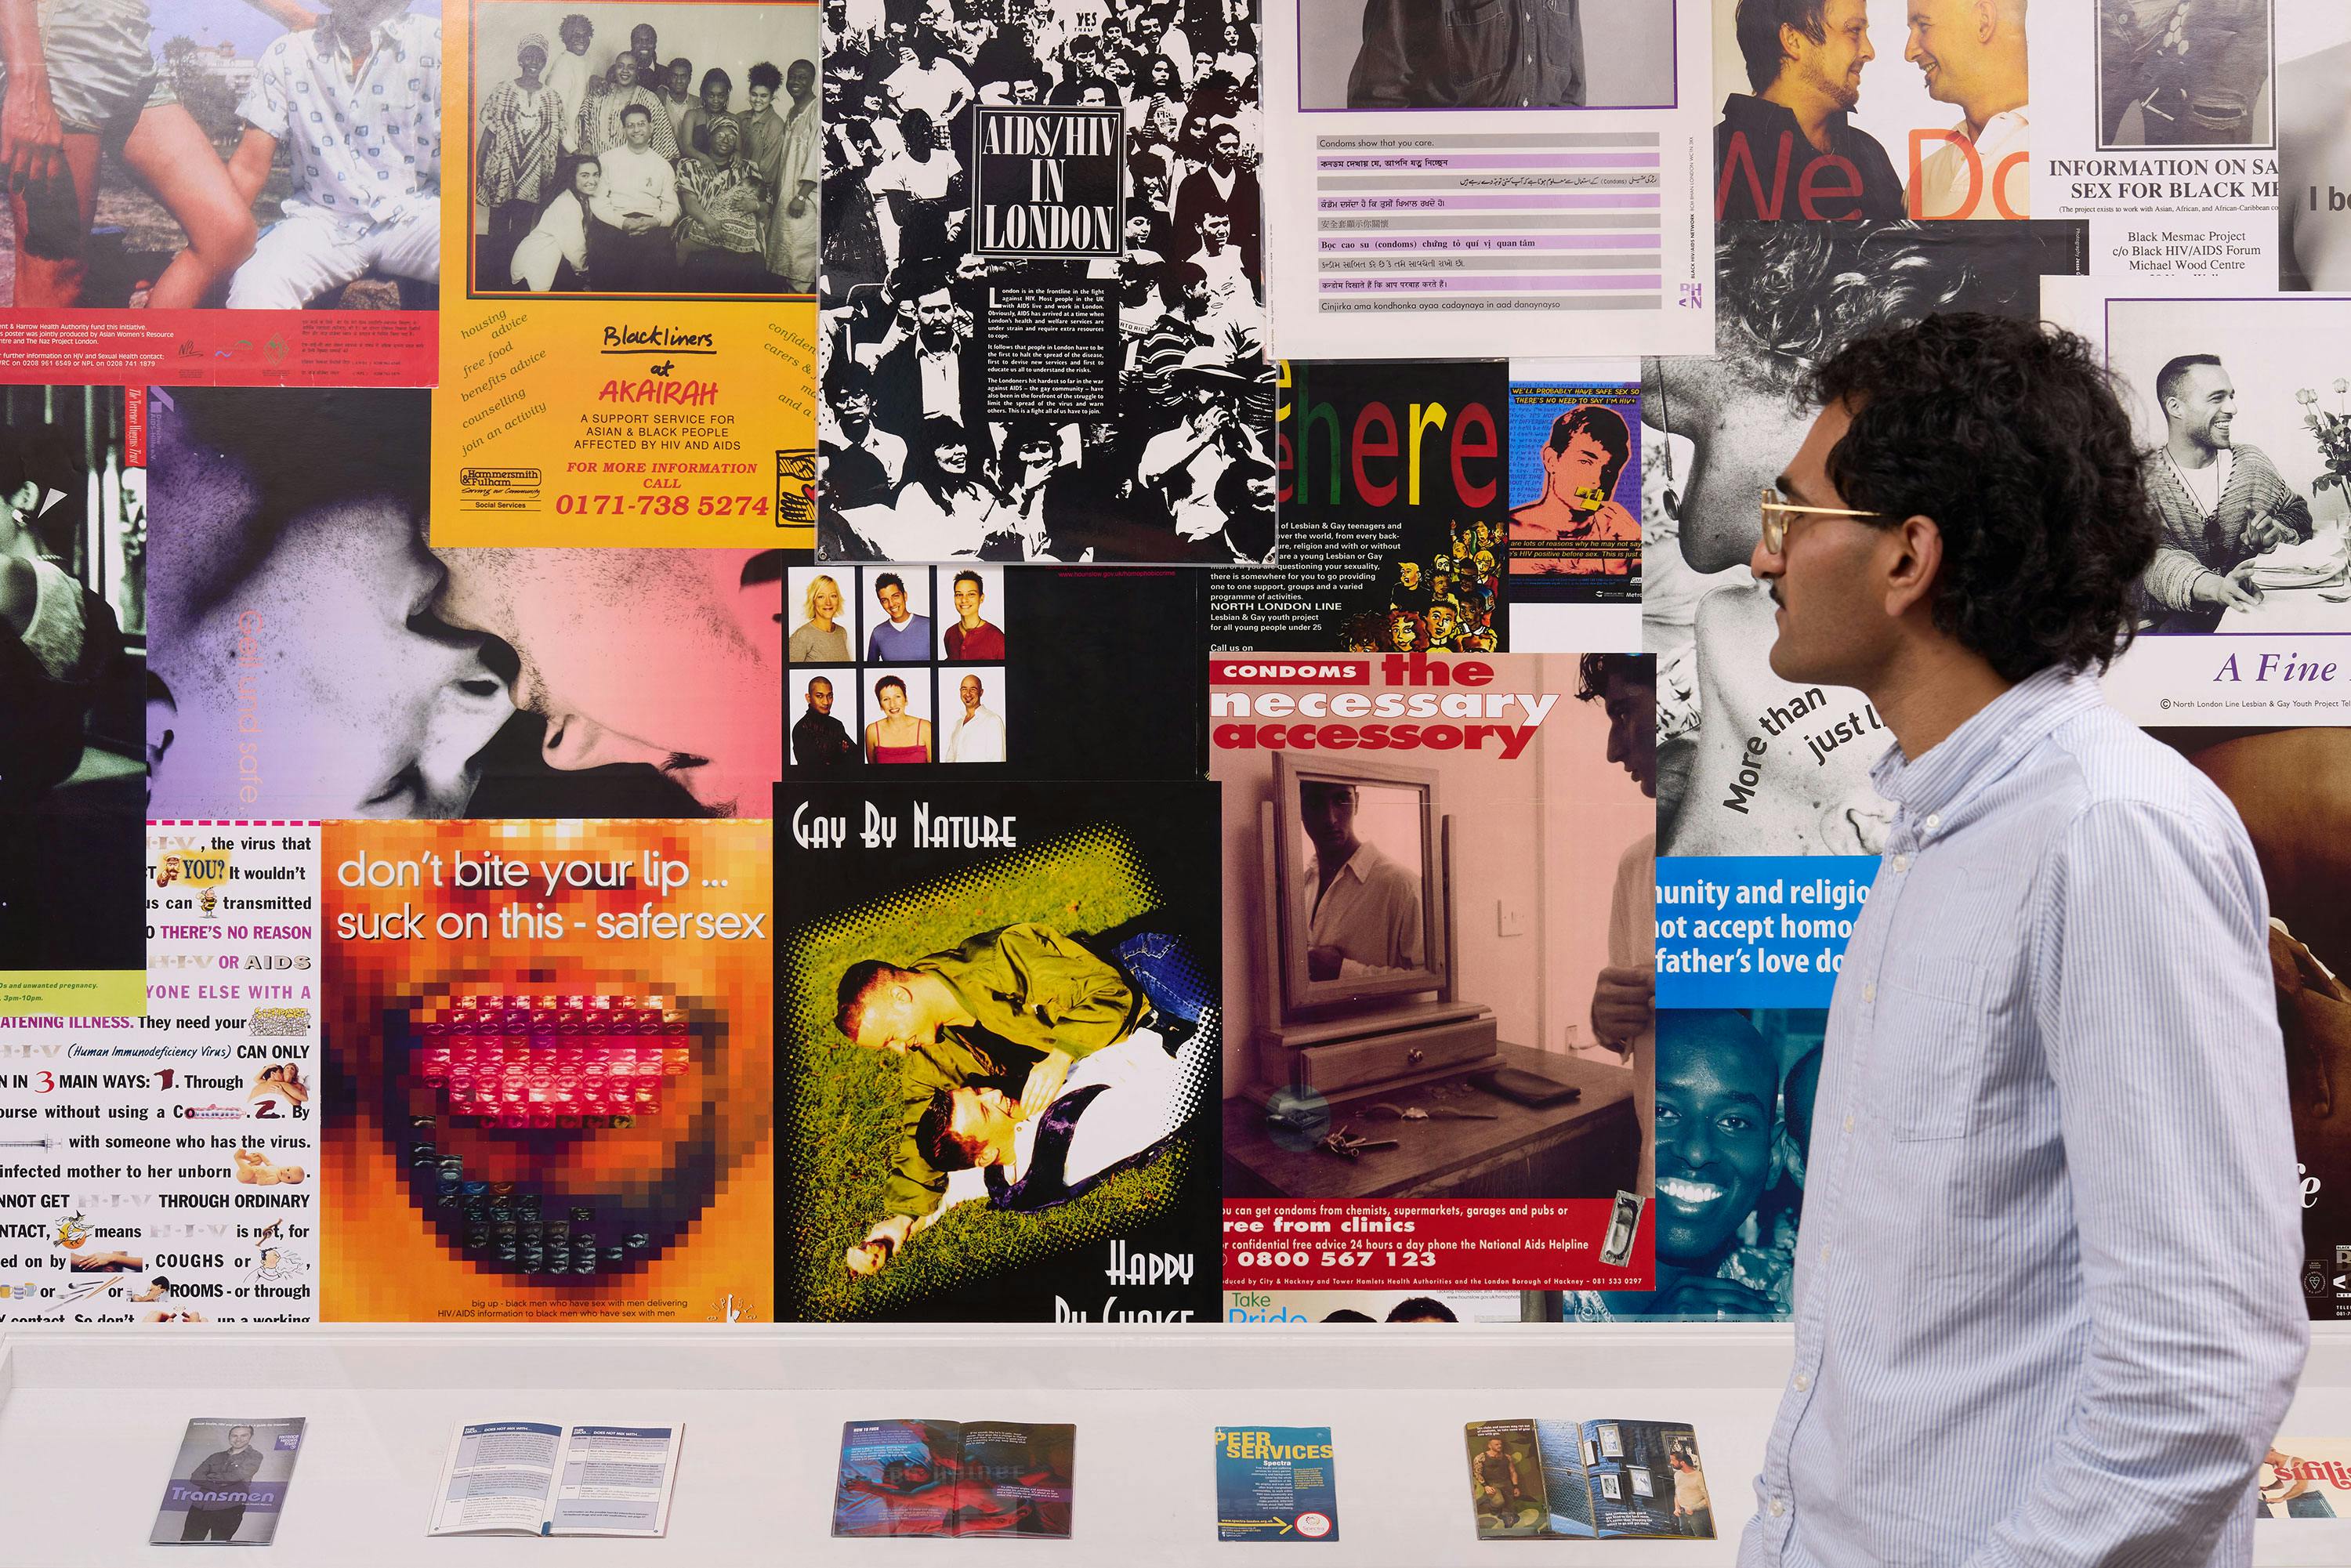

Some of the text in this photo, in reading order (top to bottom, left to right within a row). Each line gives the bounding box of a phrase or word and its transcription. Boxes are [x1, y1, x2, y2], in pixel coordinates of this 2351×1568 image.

[1076, 12, 1097, 27] YES
[982, 116, 1118, 157] AIDS/HIV
[2050, 159, 2277, 176] INFORMATION ON SA
[1030, 159, 1066, 202] IN
[2071, 182, 2244, 198] SEX FOR BLACK
[984, 205, 1114, 250] LONDON
[2128, 231, 2245, 244] Black Mesmac Project
[2113, 245, 2260, 257] c/o Black HIV/AIDS Forum
[2129, 260, 2244, 270] Michael Wood Centre
[460, 310, 507, 339] housing
[491, 313, 528, 339] advice
[604, 324, 712, 346] Blackliners
[462, 342, 514, 378] free food
[650, 360, 675, 377] at
[598, 379, 718, 407] AKAIRAH
[462, 386, 526, 429] counselling
[592, 414, 649, 423] SUPPORT
[654, 415, 705, 424] SERVICE
[711, 415, 734, 425] FOR
[586, 427, 728, 436] ASIAN & BLACK PEOPLE
[574, 440, 740, 450] AFFECTED BY HIV AND AIDS
[567, 462, 757, 473] FOR MORE INFORMATION
[462, 475, 470, 483] &
[643, 478, 681, 489] CALL
[556, 494, 769, 516] 0171-738 5274
[1223, 653, 1495, 686] CONDOMS the
[2213, 652, 2337, 682] A Fine
[1210, 693, 1561, 726] necessary
[1212, 724, 1540, 760] accessory
[1722, 687, 1865, 814] More than just
[211, 837, 311, 851] the virus that
[183, 860, 225, 879] YOU?
[338, 850, 690, 896] don't bite your lip
[1736, 879, 1784, 904] and
[223, 896, 311, 909] transmitted
[337, 903, 425, 940] suck
[436, 911, 488, 940] on
[499, 903, 563, 940] this
[161, 926, 311, 939] THERE'S NO REASON
[1694, 918, 1774, 945] accept
[219, 955, 312, 970] OR AIDS
[1759, 947, 1809, 973] love
[68, 1043, 231, 1059] (Human Immunodeficiency Virus)
[159, 1193, 311, 1208] THROUGH ORDINARY
[1273, 1216, 1415, 1232] from clinics
[156, 1254, 223, 1267] COUGHS
[1238, 1251, 1436, 1266] 0800 567 123
[1226, 1445, 1333, 1459] SERVICES
[172, 1487, 274, 1501] Transmen
